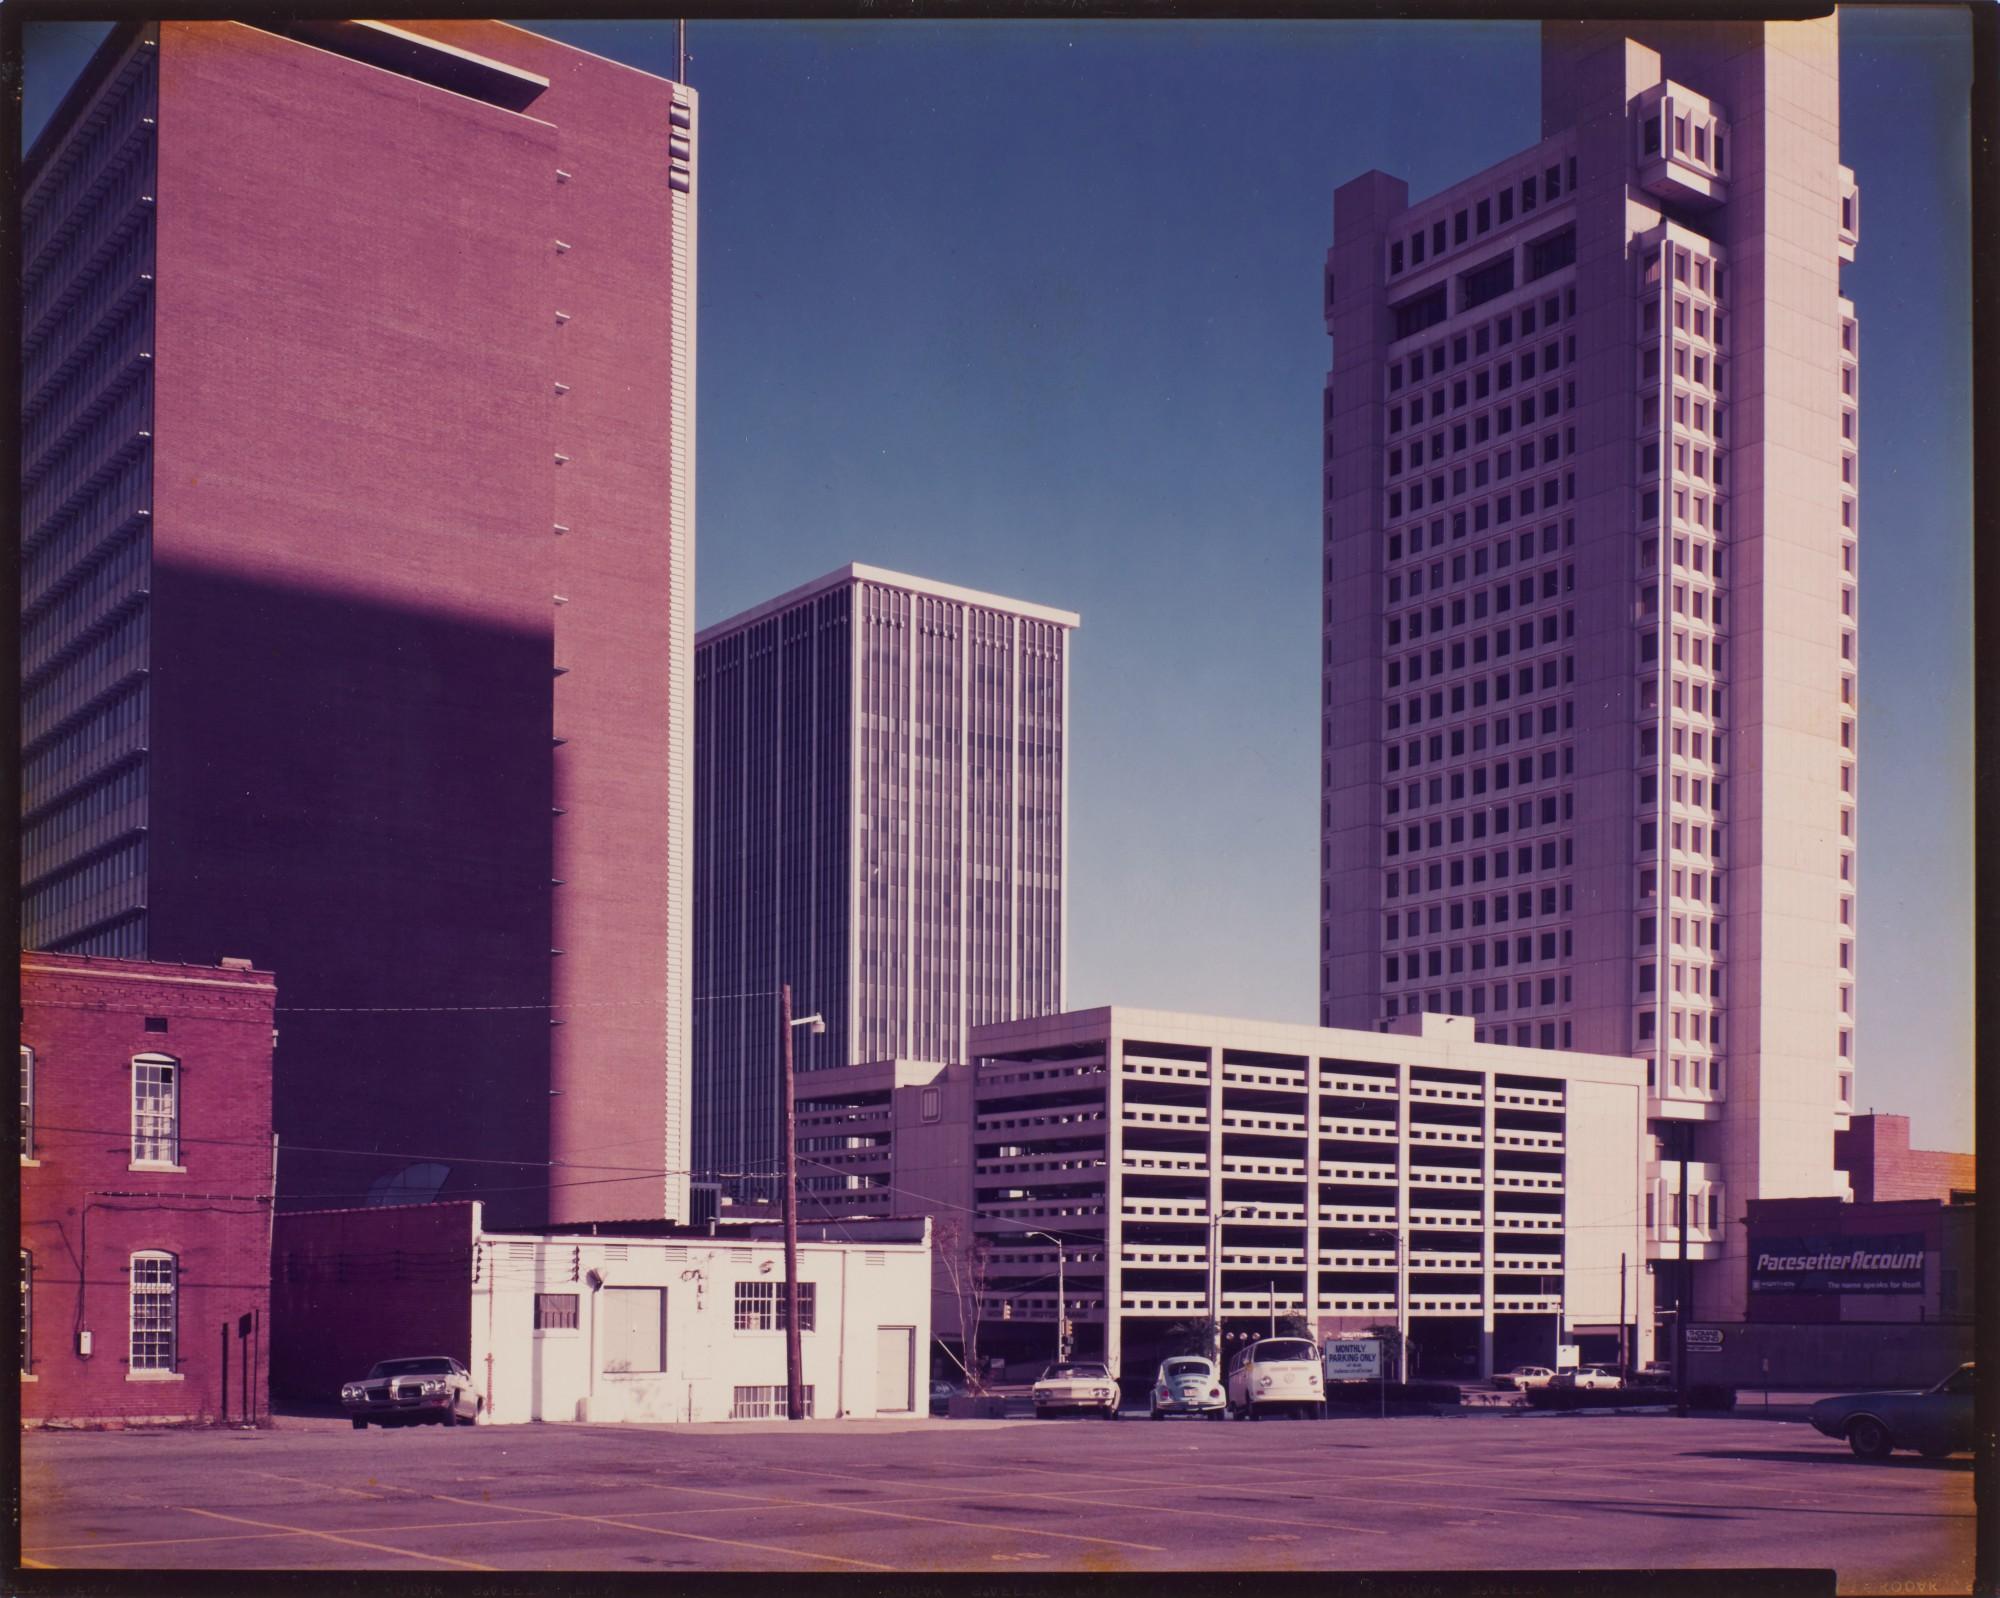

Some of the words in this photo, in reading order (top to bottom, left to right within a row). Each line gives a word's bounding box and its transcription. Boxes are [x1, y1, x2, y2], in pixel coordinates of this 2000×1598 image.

[1850, 1250, 1924, 1270] Account
[1827, 1281, 1839, 1289] The
[1863, 1281, 1888, 1290] speaks
[1890, 1281, 1901, 1289] for
[1335, 1344, 1367, 1353] MONTHLY
[1328, 1353, 1359, 1362] PARKING
[1360, 1353, 1377, 1362] ONLY
